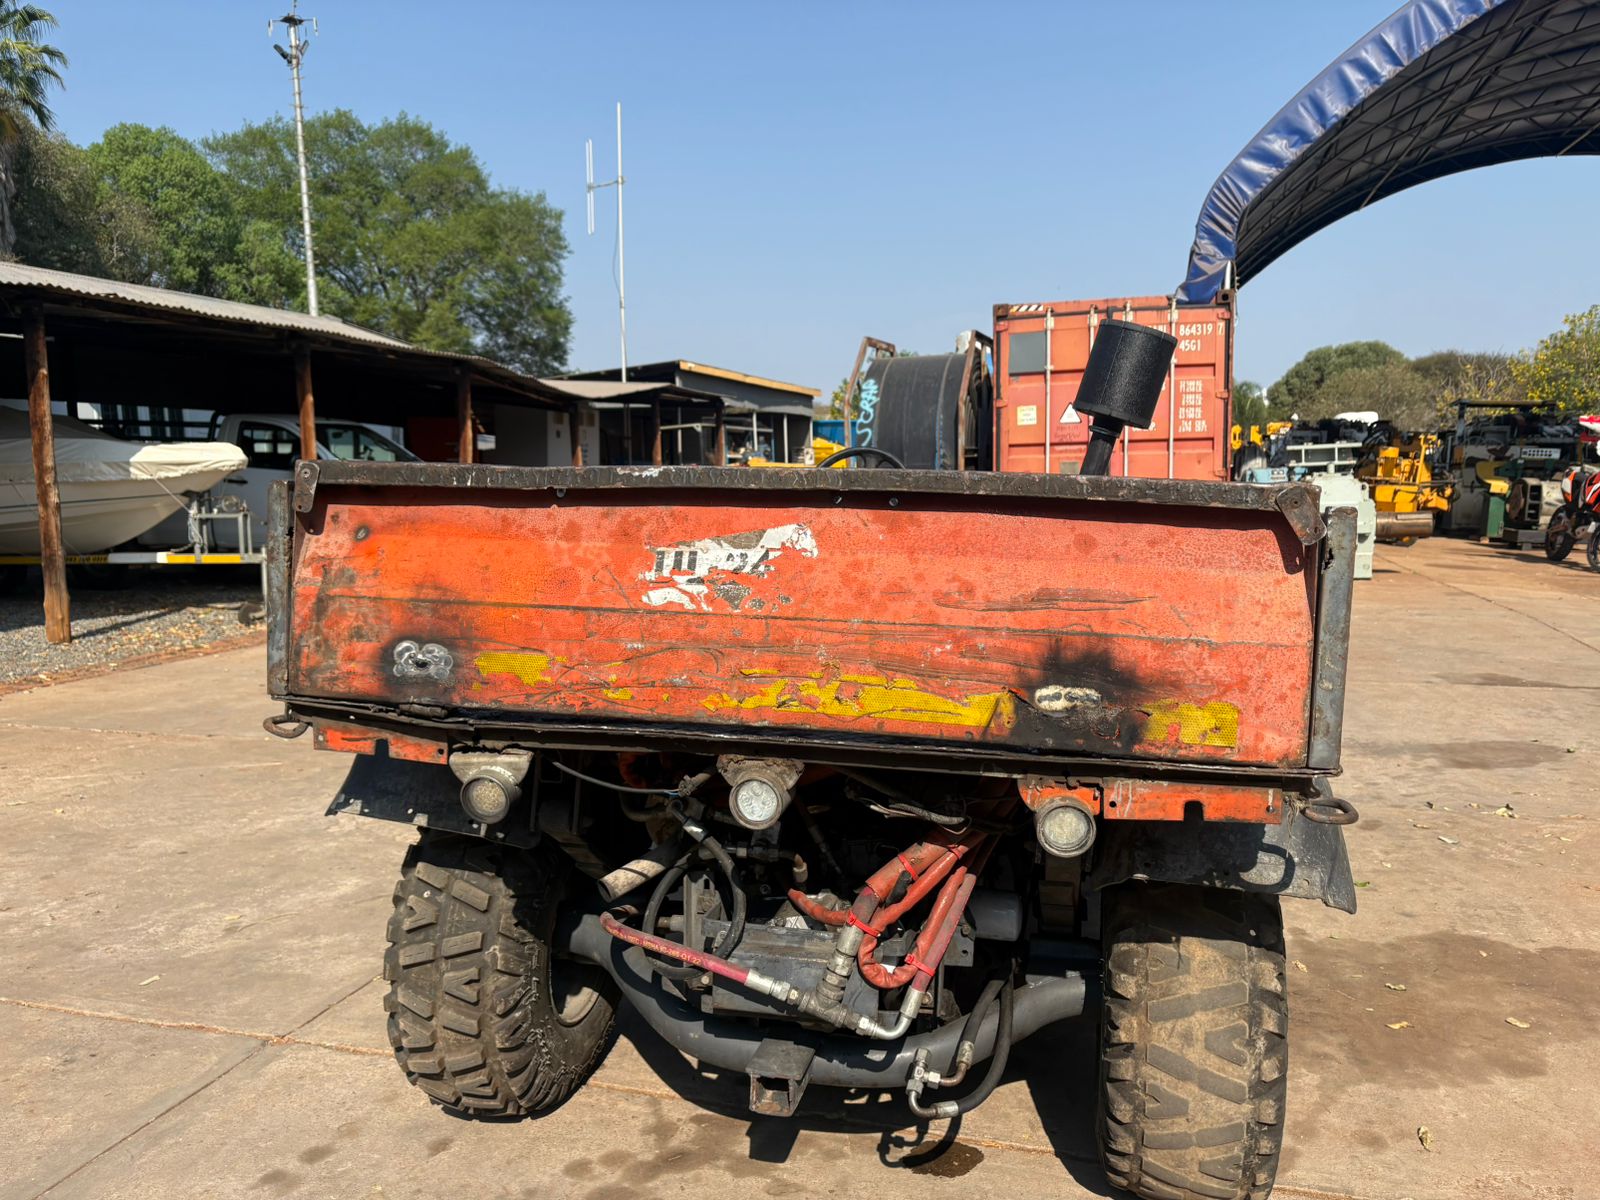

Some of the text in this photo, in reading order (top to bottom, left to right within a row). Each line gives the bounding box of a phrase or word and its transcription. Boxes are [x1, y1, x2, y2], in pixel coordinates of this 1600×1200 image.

[1179, 322, 1213, 336] 864319
[1179, 338, 1201, 352] 45G1
[856, 378, 881, 447] SCRAP
